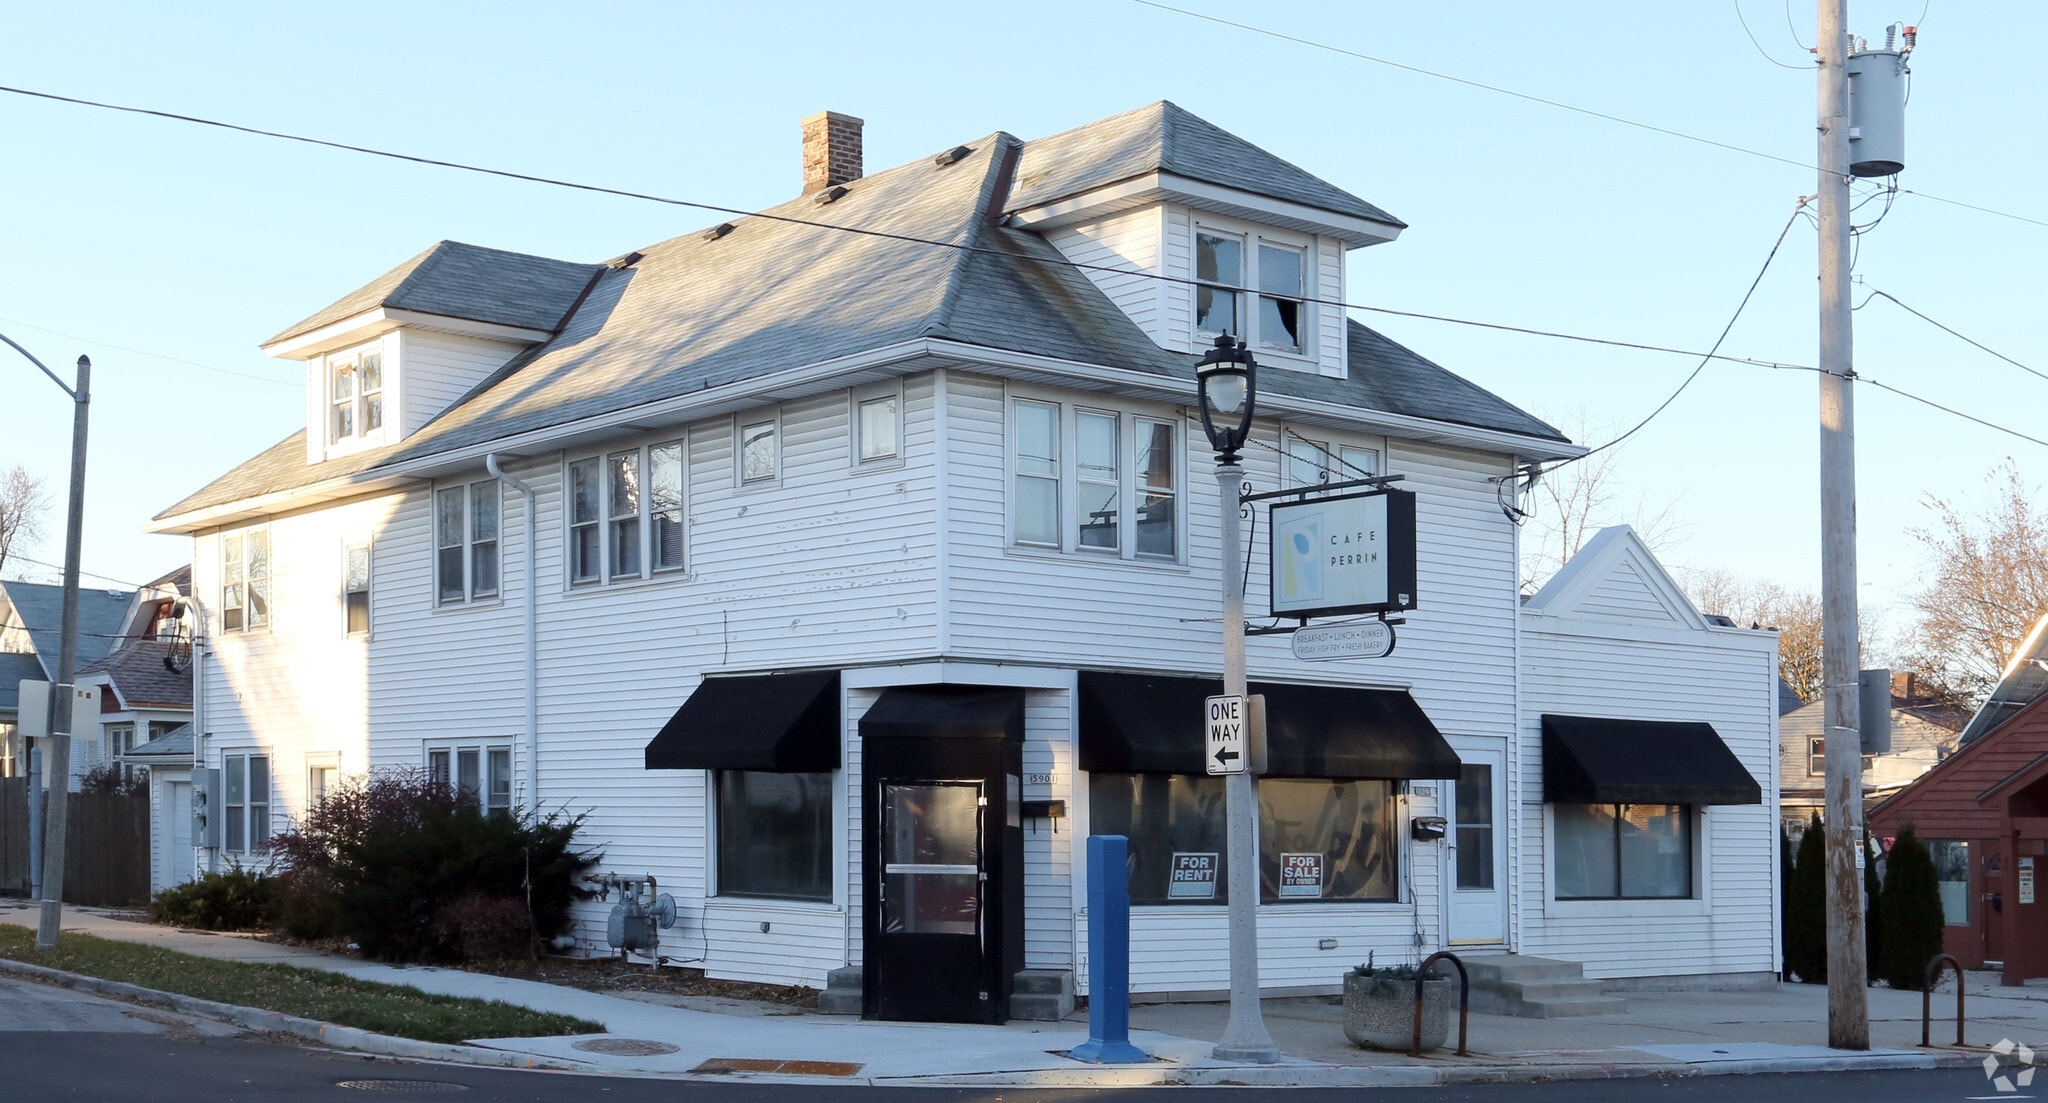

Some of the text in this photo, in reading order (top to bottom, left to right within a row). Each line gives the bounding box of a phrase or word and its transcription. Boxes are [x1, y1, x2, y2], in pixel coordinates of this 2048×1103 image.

[1330, 530, 1376, 546] CAFE
[1331, 552, 1377, 567] PERRIN
[1297, 629, 1384, 643] BREAKFAST LUNCH DINNER
[1297, 646, 1316, 654] FRIDAY
[1345, 642, 1362, 650] FRESH
[1363, 641, 1383, 649] BAKERY
[1211, 702, 1239, 720] ONE
[1211, 723, 1240, 742] WAY
[1032, 774, 1055, 783] 5901
[1180, 857, 1209, 869] FOR
[1289, 856, 1315, 867] FOR
[1174, 869, 1213, 881] RENT
[1284, 867, 1320, 878] SALE
